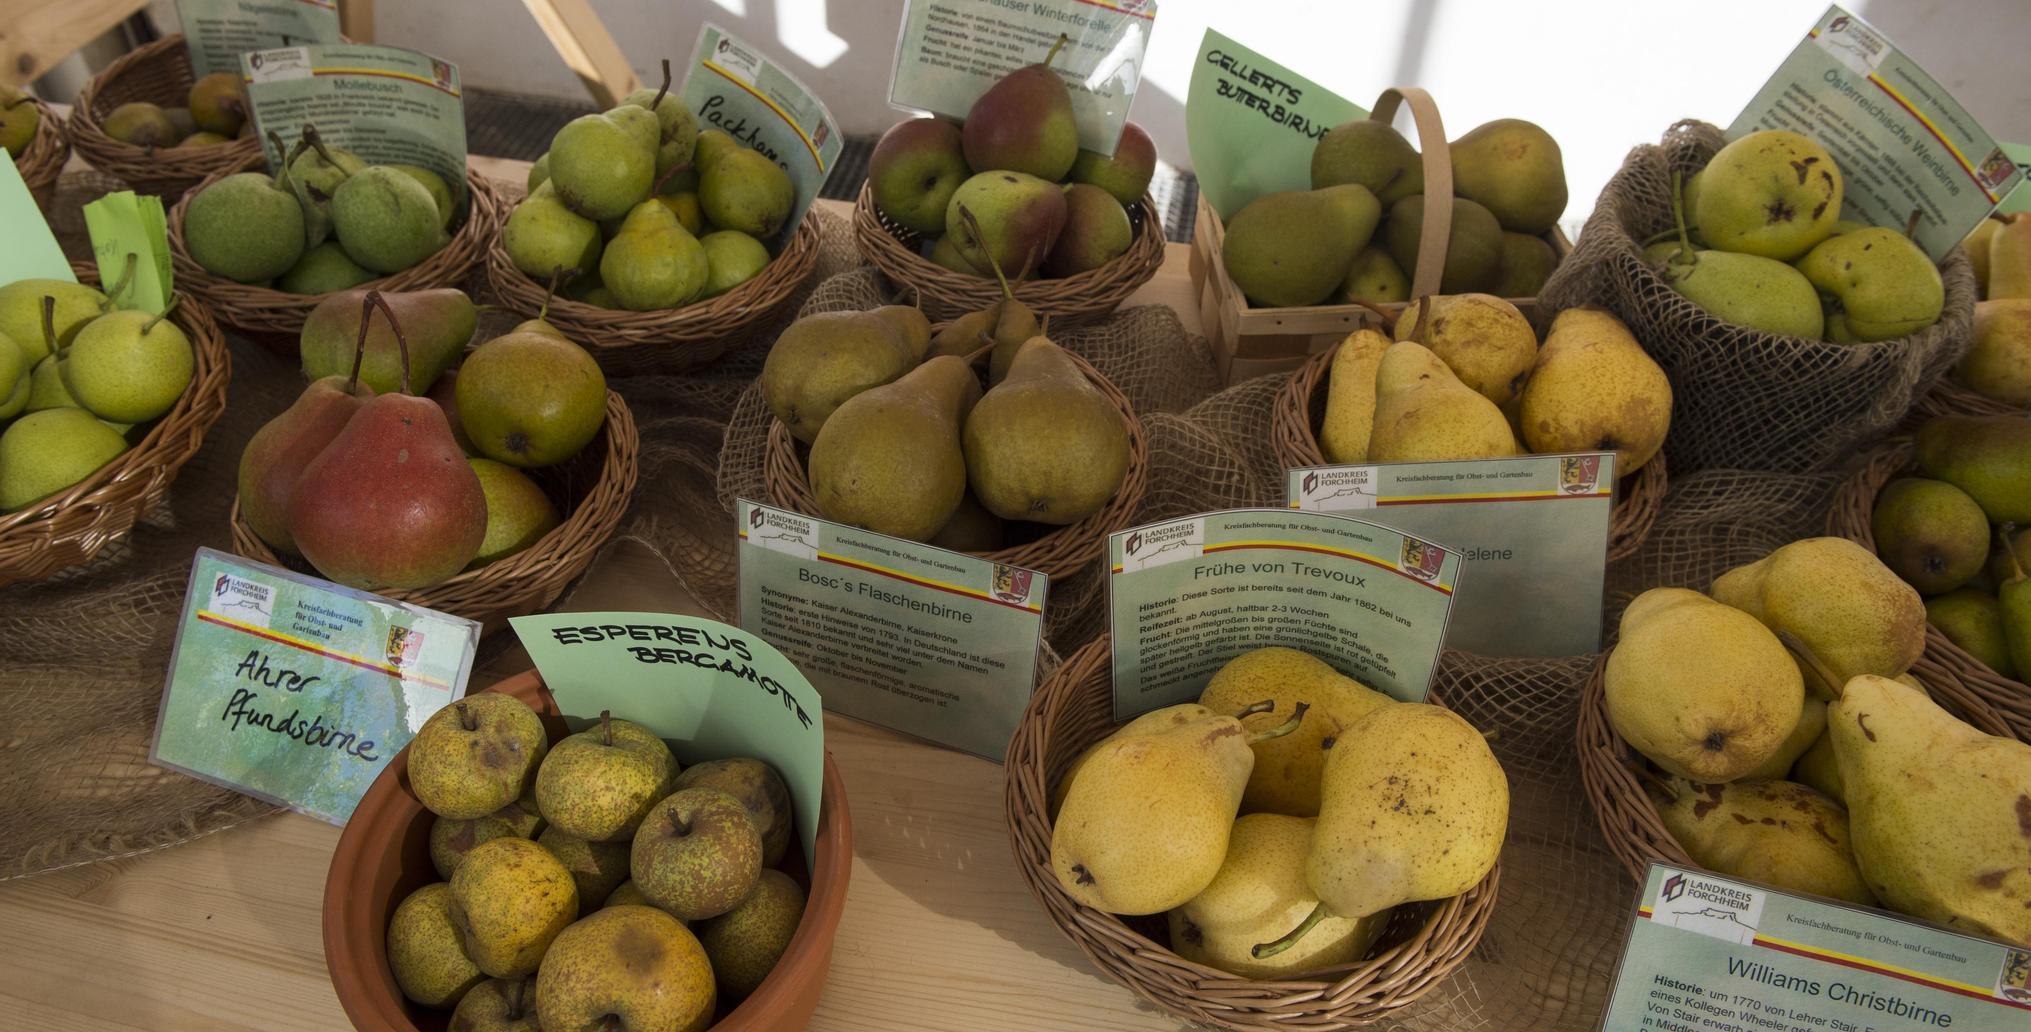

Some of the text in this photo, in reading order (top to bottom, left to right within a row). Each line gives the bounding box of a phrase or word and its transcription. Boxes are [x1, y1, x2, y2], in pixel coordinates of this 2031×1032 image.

[1033, 3, 1112, 33] Winterforelle
[333, 78, 402, 93] Mollebusch
[1823, 68, 1913, 146] Österreichische
[1912, 139, 1960, 197] Weinbirne
[1321, 470, 1368, 482] LANDKREIS
[1321, 476, 1368, 487] FORCHHEIM
[1396, 474, 1453, 483] Kreisfachberatung
[1466, 472, 1482, 480] Obst-
[1500, 471, 1533, 479] Gartenbau
[765, 512, 810, 531] LANDKREIS
[766, 518, 810, 536] FORCHHEIM
[1145, 522, 1195, 542] LANDKREIS
[1224, 522, 1286, 531] Kreisfachberatung
[1300, 524, 1319, 533] Obst-
[1321, 527, 1335, 535] und
[1336, 529, 1373, 543] Gartenbau
[1145, 529, 1194, 545] FORCHHEIM
[836, 536, 891, 556] Kreisfachberatung
[892, 549, 901, 558] für
[920, 558, 933, 566] und
[933, 560, 966, 574] Gartenbau
[231, 579, 269, 597] LANDKREIS
[1194, 561, 1366, 588] Frühe von Trevoux
[230, 585, 268, 602] FORCHHEIM
[858, 582, 975, 624] Flaschenbirne
[1181, 590, 1208, 602] Diese
[1210, 585, 1235, 596] Sorte
[1238, 584, 1249, 592] ist
[1251, 584, 1284, 592] bereits
[1286, 586, 1304, 595] seit
[1305, 587, 1328, 598] dem
[1330, 592, 1351, 603] Jahr
[1378, 607, 1394, 619] bei
[1395, 615, 1412, 628] uns
[295, 611, 343, 632] für Obst- und
[296, 600, 364, 627] Kreisfachberatung
[761, 585, 958, 645] Synonyme: Kaiser Alexanderbirne, Kaiserkrone
[1139, 607, 1177, 623] bekannt.
[1139, 604, 1330, 634] Reifezeit: ab August, haltbar 2-3 Wochen
[1175, 626, 1191, 636] Die
[1192, 616, 1249, 631] mittelgroßen
[1251, 615, 1265, 623] bis
[1267, 616, 1302, 626] großen
[1338, 628, 1359, 639] sind
[292, 622, 331, 640] Gartenbau
[551, 624, 753, 662] ESPERENS
[761, 606, 989, 675] Sorte seit 1810 bekannt und sehr viel unter dem Namen
[1139, 633, 1201, 657] glockenförmig
[1202, 627, 1220, 638] und
[1221, 625, 1251, 634] haben
[1253, 624, 1273, 632] eine
[1275, 626, 1338, 642] grünlichgelbe
[1375, 653, 1389, 663] die
[1139, 651, 1167, 669] später
[1169, 639, 1204, 659] hellgelb
[1204, 635, 1237, 651] gefärbt
[1255, 633, 1271, 641] Die
[1273, 634, 1331, 652] Sonnenseite
[1332, 643, 1345, 656] ist
[1345, 649, 1359, 661] rot
[1358, 655, 1397, 681] getüpfelt
[235, 650, 321, 693] Ahrer
[627, 646, 813, 730] BERGAMOTTE
[222, 688, 379, 762] Pfundsbirne
[1687, 879, 1752, 903] LANDKREIS
[1687, 888, 1750, 911] FORCHHEIM
[1786, 913, 1967, 964] Kreisfachberatung für Obst- und Gartenbau
[1654, 974, 1706, 996] Historie:
[1709, 990, 1729, 1002] um
[1733, 995, 1762, 1011] 1770
[1764, 1005, 1786, 1017] von
[1788, 1009, 1828, 1027] Lehrer
[1729, 956, 1952, 1028] Williams Christbirne
[1642, 1014, 1653, 1026] in
[1647, 1001, 1743, 1032] Von Stair erwarb
[1650, 989, 1794, 1032] eines Kollegen Wheeler
